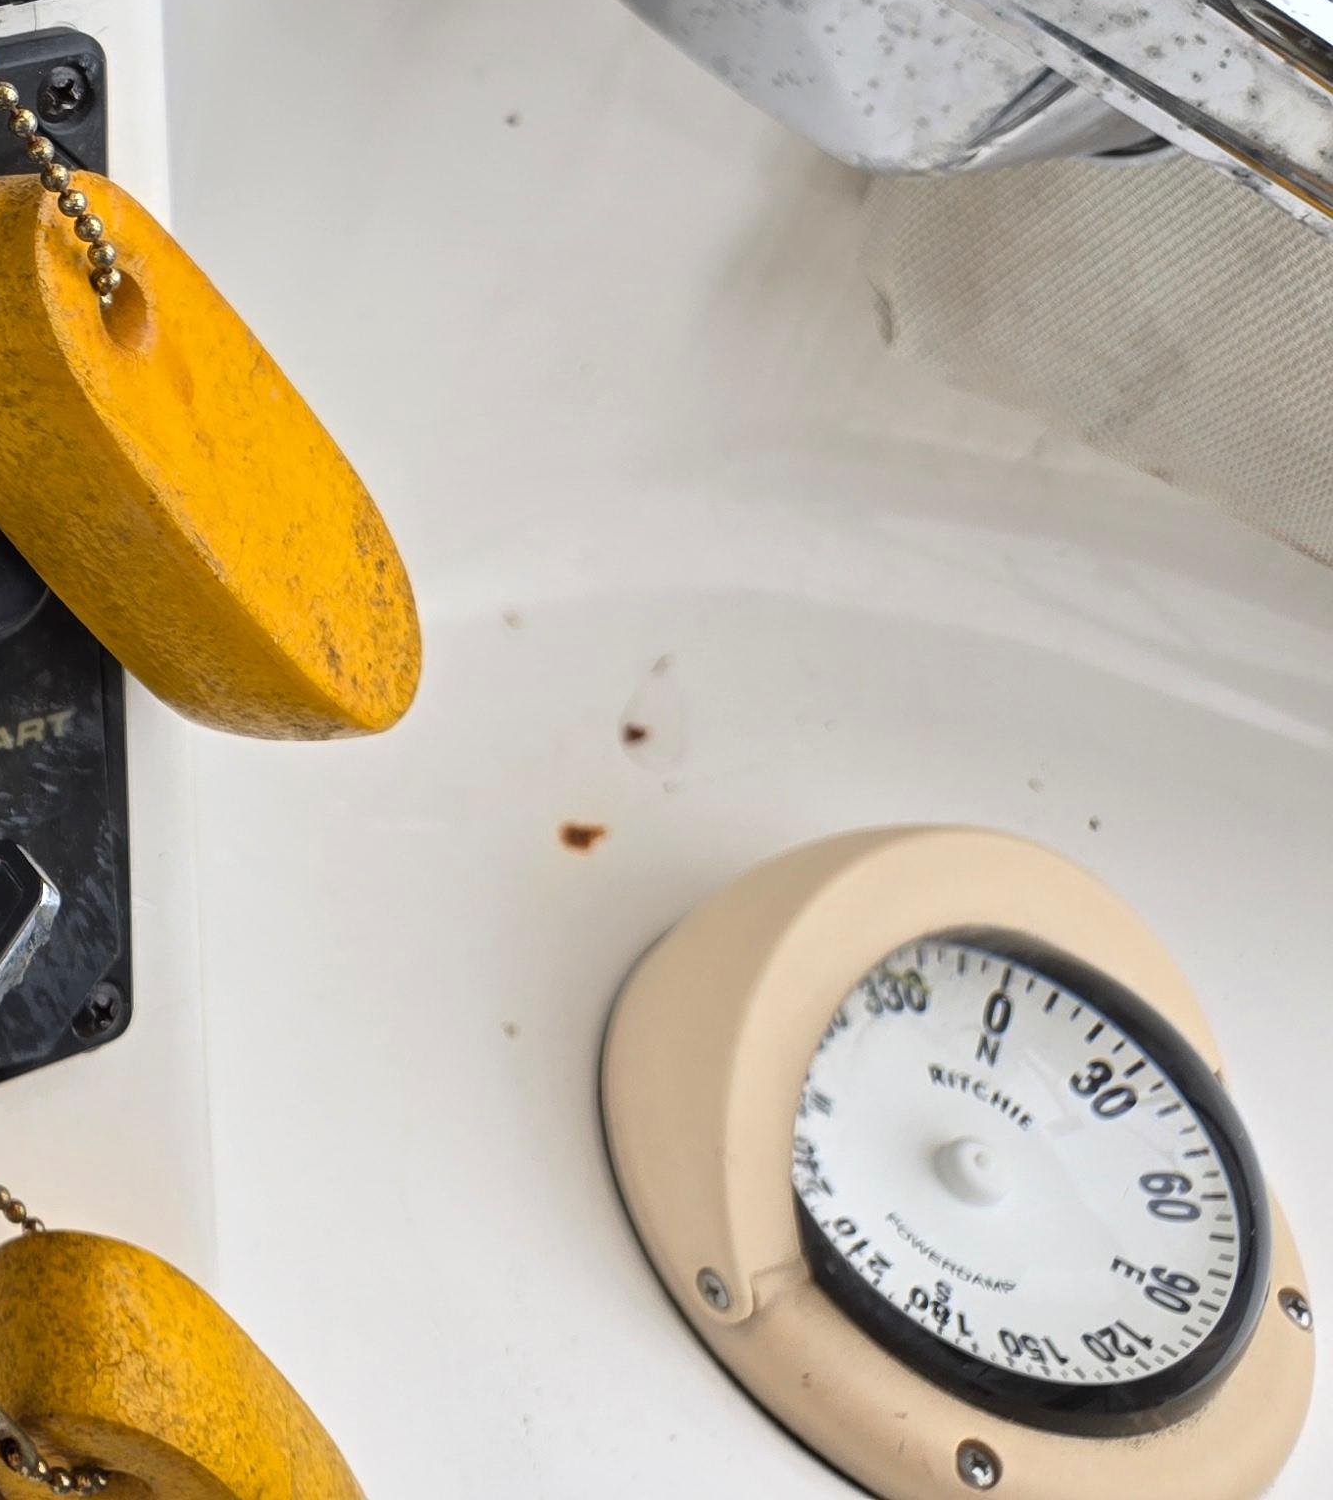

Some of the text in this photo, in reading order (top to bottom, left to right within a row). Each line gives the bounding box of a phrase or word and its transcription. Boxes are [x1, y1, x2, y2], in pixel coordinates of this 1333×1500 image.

[983, 990, 1012, 1034] 0
[977, 1037, 1001, 1068] N
[928, 1064, 1034, 1129] RITCHIE
[1070, 1059, 1137, 1119] 30
[1139, 1172, 1200, 1224] 60
[1111, 1256, 1147, 1284] E
[1145, 1265, 1200, 1314] 90
[998, 1328, 1069, 1366] 150
[1081, 1321, 1154, 1363] 120
